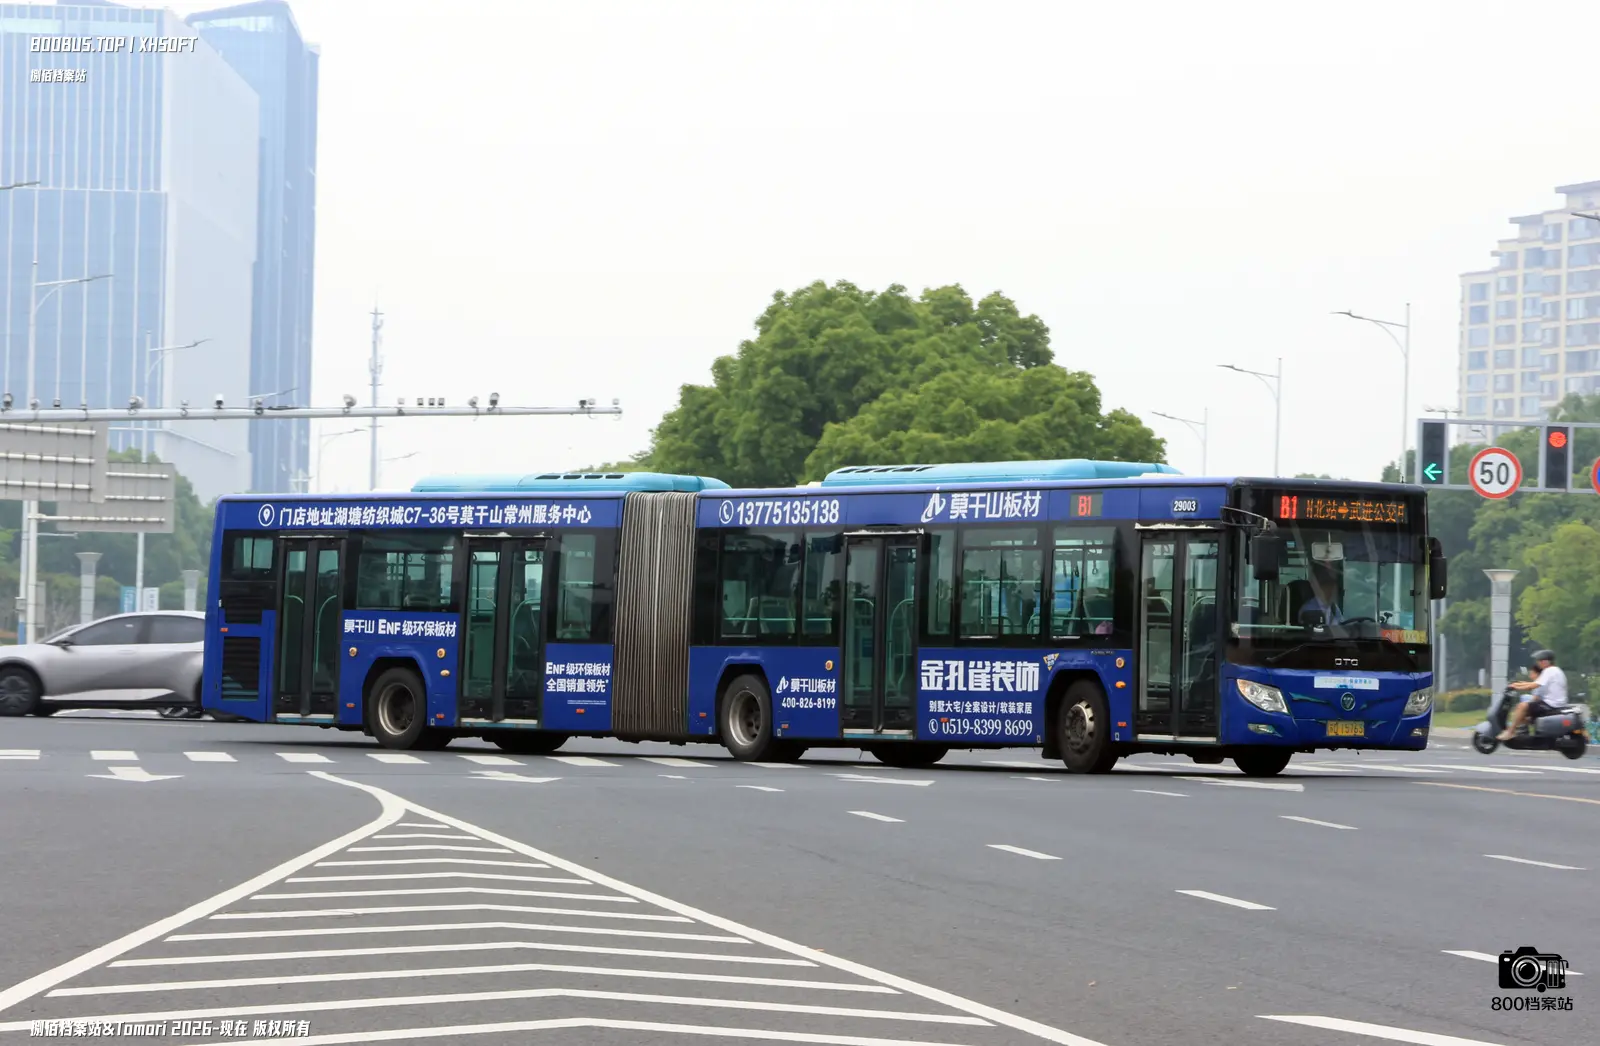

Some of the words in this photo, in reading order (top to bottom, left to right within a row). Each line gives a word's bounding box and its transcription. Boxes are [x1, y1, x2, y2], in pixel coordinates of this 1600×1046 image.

[1480, 461, 1509, 485] 50
[737, 499, 840, 525] 13775135138
[950, 491, 1041, 519] 莫干山板材
[1078, 495, 1092, 517] B1
[1173, 500, 1197, 512] 29003
[1280, 495, 1298, 519] B1
[790, 678, 836, 693] 莫干山板材
[920, 660, 1040, 692] 金孔雀装饰
[781, 697, 836, 709] 400-826-8199
[1004, 719, 1033, 736] 8699
